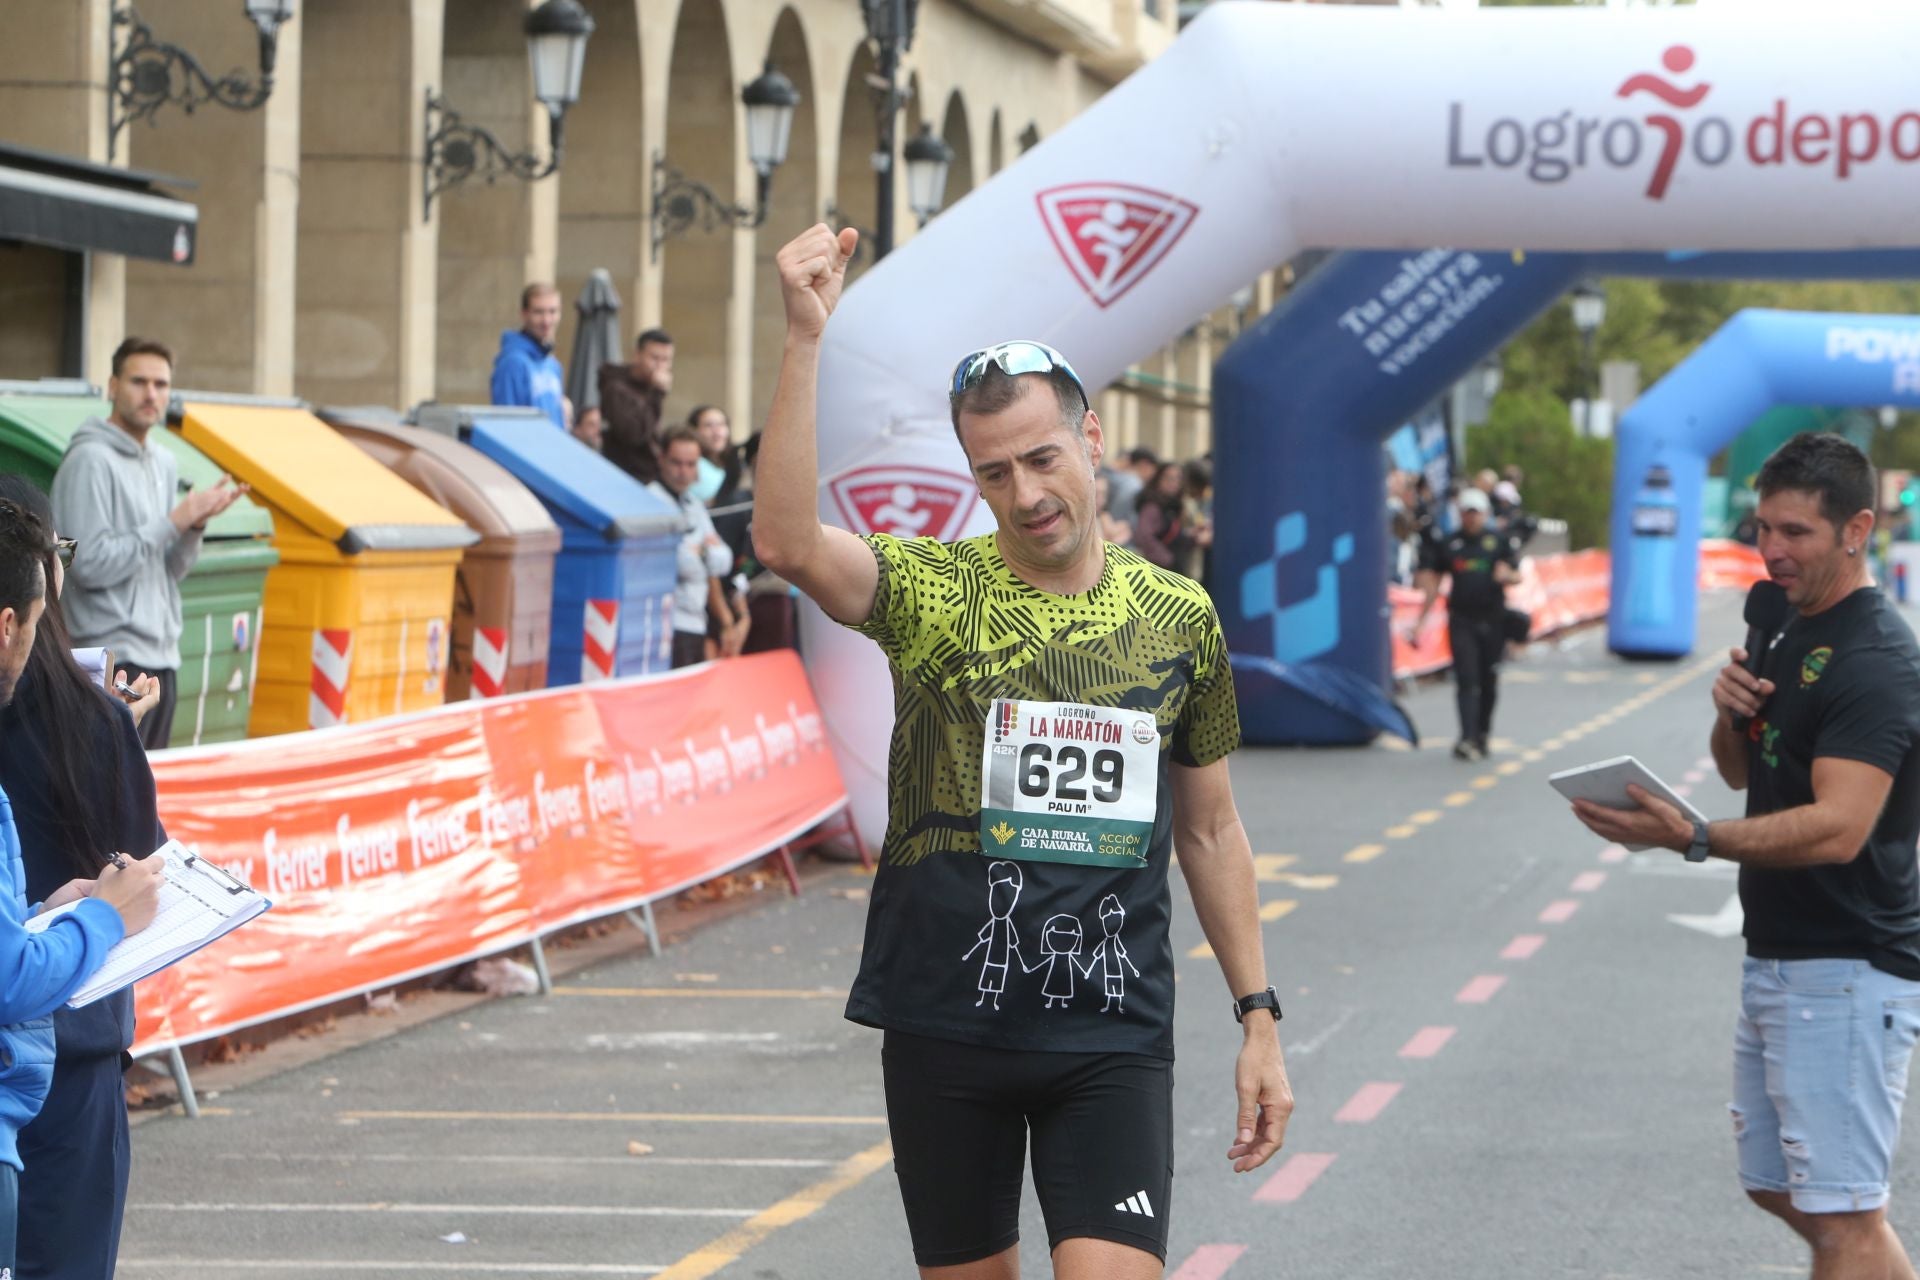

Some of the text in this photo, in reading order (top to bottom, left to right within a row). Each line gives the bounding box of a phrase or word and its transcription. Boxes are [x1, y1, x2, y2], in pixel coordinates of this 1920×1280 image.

[1364, 252, 1482, 357] nuestra
[1338, 298, 1386, 335] Tu
[1058, 706, 1096, 720] LOGROÑO
[1029, 716, 1123, 744] LA MARATÓN
[993, 745, 1017, 756] 42K
[1018, 743, 1124, 803] 629
[1047, 801, 1073, 812] PAU
[1021, 827, 1090, 842] CAJA RURAL
[1099, 833, 1141, 845] ACCIÓN
[263, 826, 329, 898] ferrer
[336, 813, 400, 887] ferrer
[407, 798, 468, 868] ferrer
[1020, 837, 1094, 853] DE NAVARRA
[1098, 845, 1137, 856] SOCIAL
